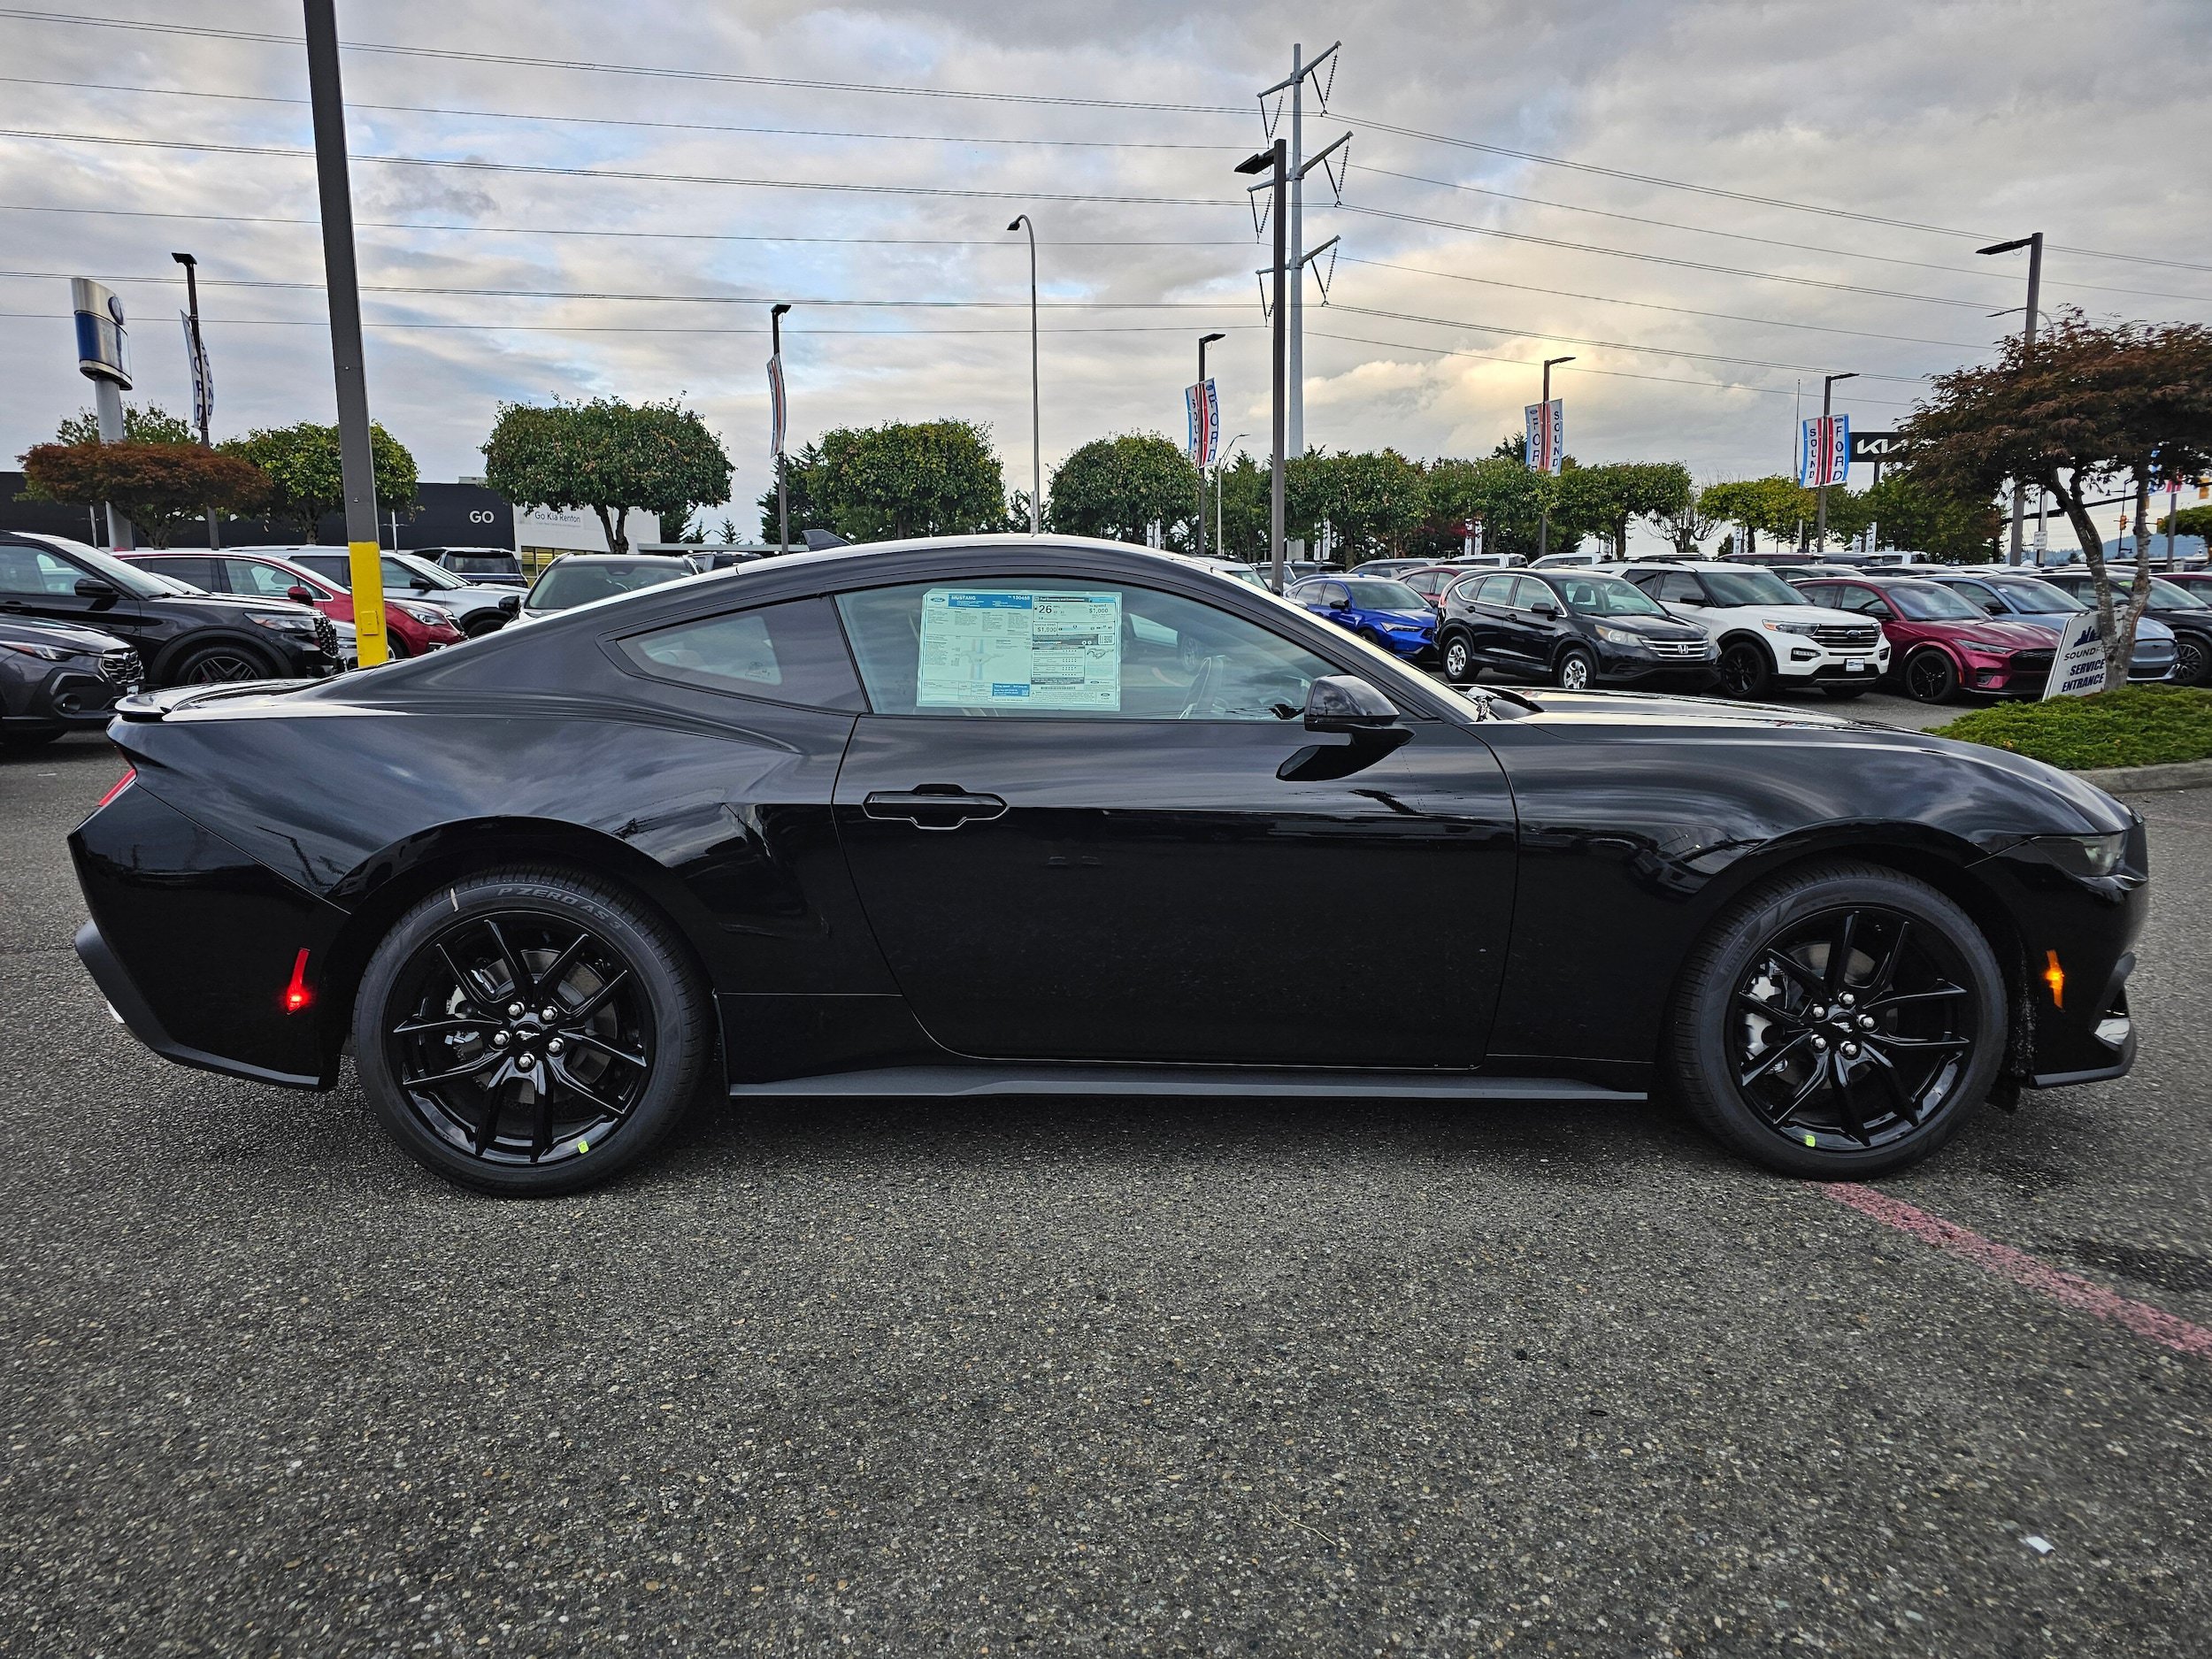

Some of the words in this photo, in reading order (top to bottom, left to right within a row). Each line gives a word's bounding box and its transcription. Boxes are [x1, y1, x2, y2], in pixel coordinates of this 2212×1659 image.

[1207, 395, 1218, 463] FORD
[1809, 428, 1817, 479] SOUND
[1832, 426, 1844, 481] FORD
[469, 510, 495, 524] GO
[534, 511, 546, 520] Go
[547, 512, 558, 521] Kia
[559, 513, 580, 523] Renton
[1039, 604, 1052, 614] 26
[2063, 645, 2106, 661] SOUNDFO
[2070, 658, 2106, 676] SERVICE
[2062, 672, 2105, 693] ENTRANCE
[497, 887, 512, 896] P
[517, 887, 579, 905] ZERO
[580, 904, 610, 920] AS
[610, 921, 622, 930] 3
